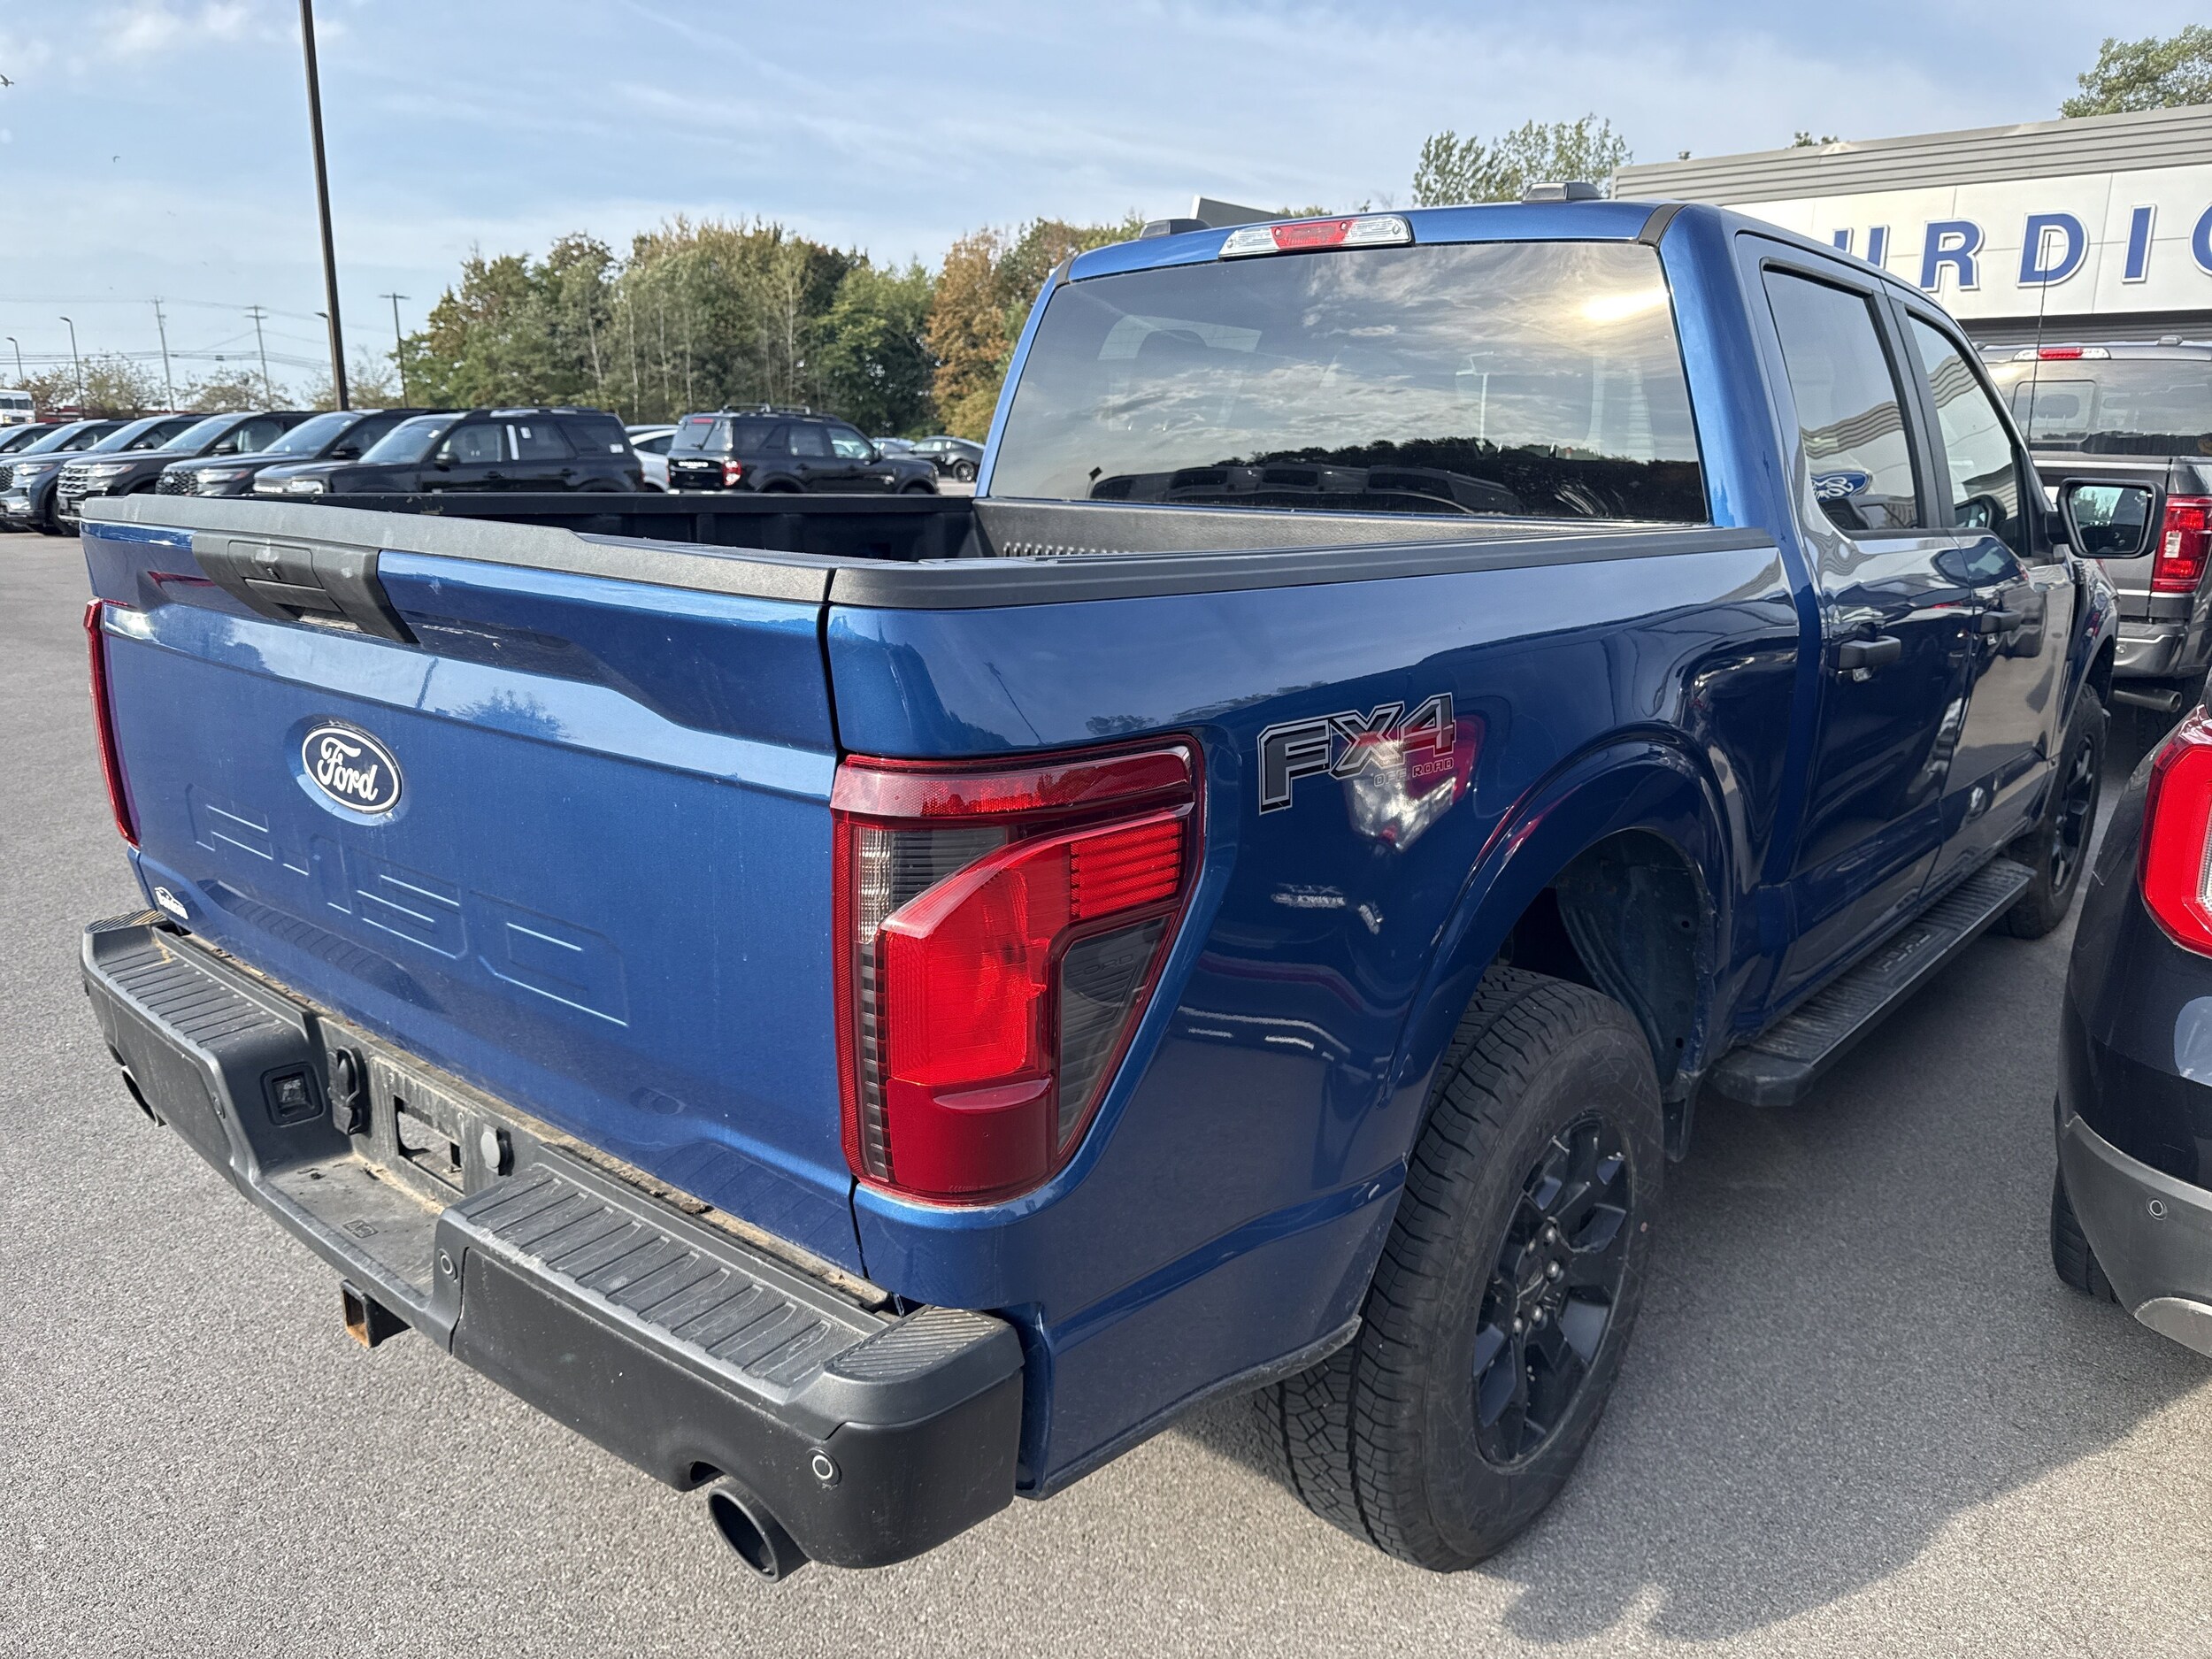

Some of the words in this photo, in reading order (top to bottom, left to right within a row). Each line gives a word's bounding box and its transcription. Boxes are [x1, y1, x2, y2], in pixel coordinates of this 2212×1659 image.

[317, 736, 379, 801] Ford
[1257, 692, 1455, 816] FX4
[1374, 768, 1407, 787] OFF
[1412, 757, 1455, 778] ROAD
